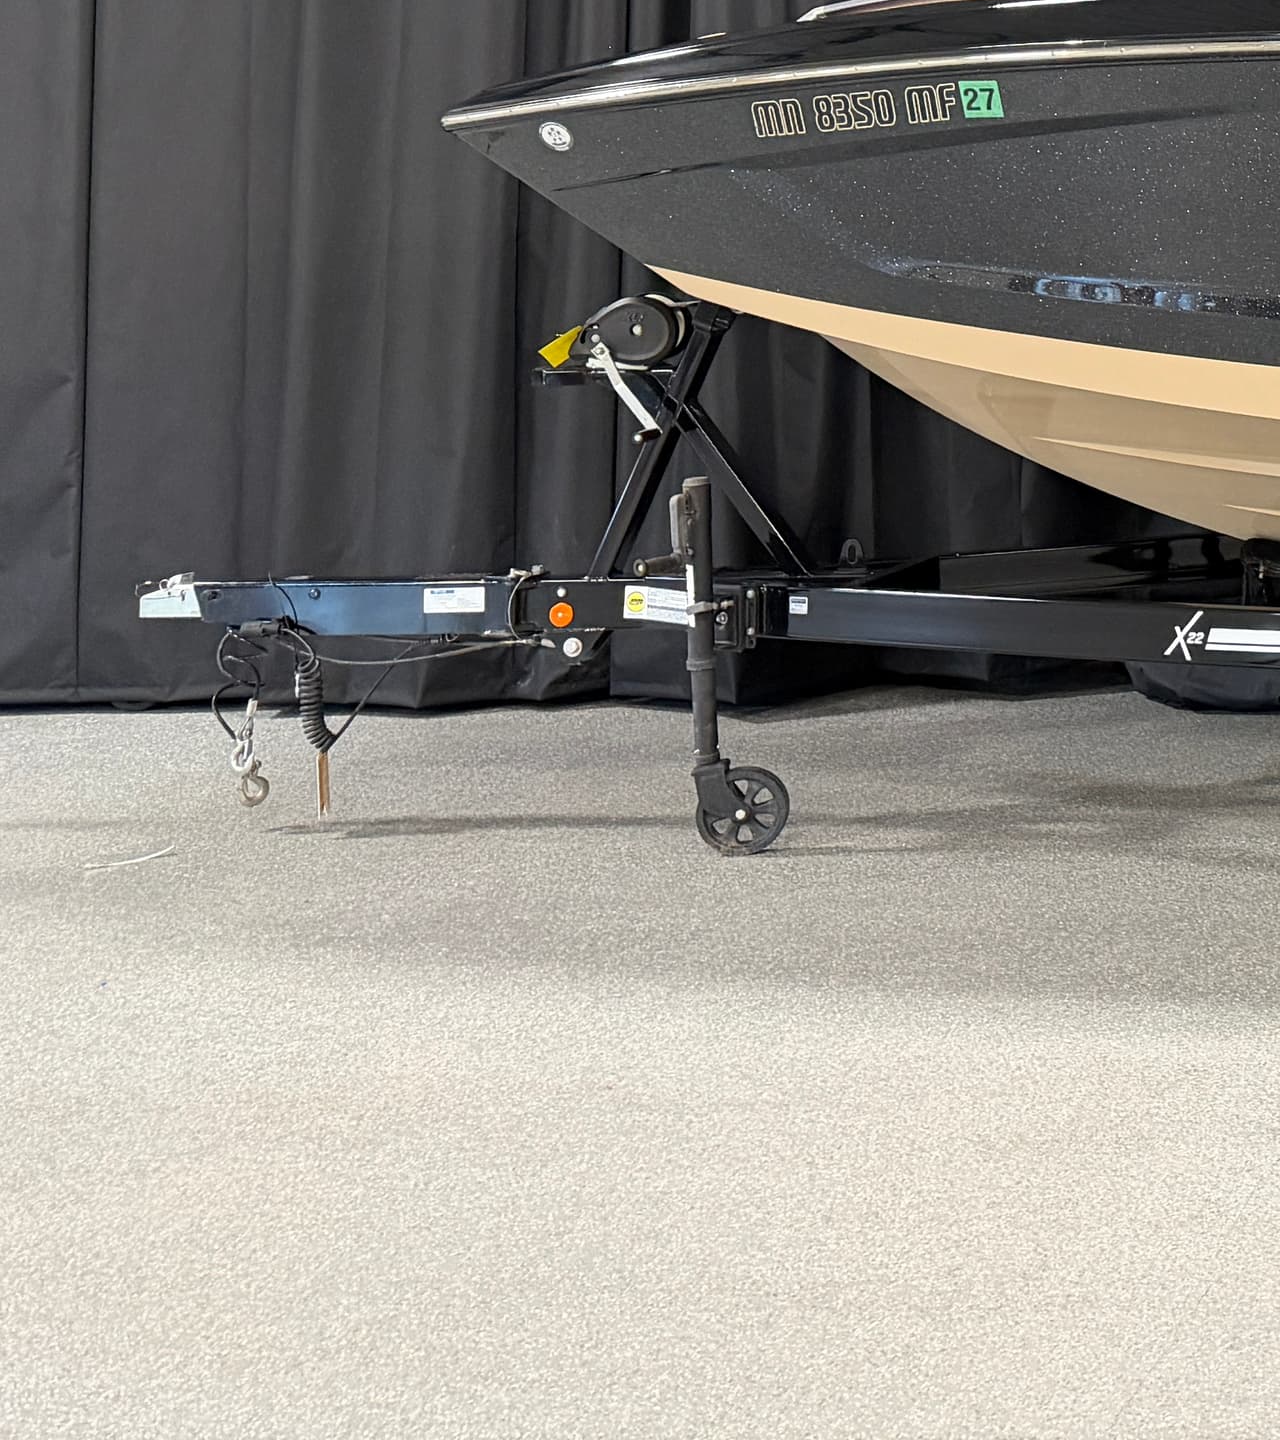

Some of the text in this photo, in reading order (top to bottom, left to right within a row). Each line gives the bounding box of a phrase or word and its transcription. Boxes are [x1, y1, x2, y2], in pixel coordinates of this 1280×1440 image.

[751, 82, 956, 138] MN 8350 MF
[963, 87, 996, 112] 27
